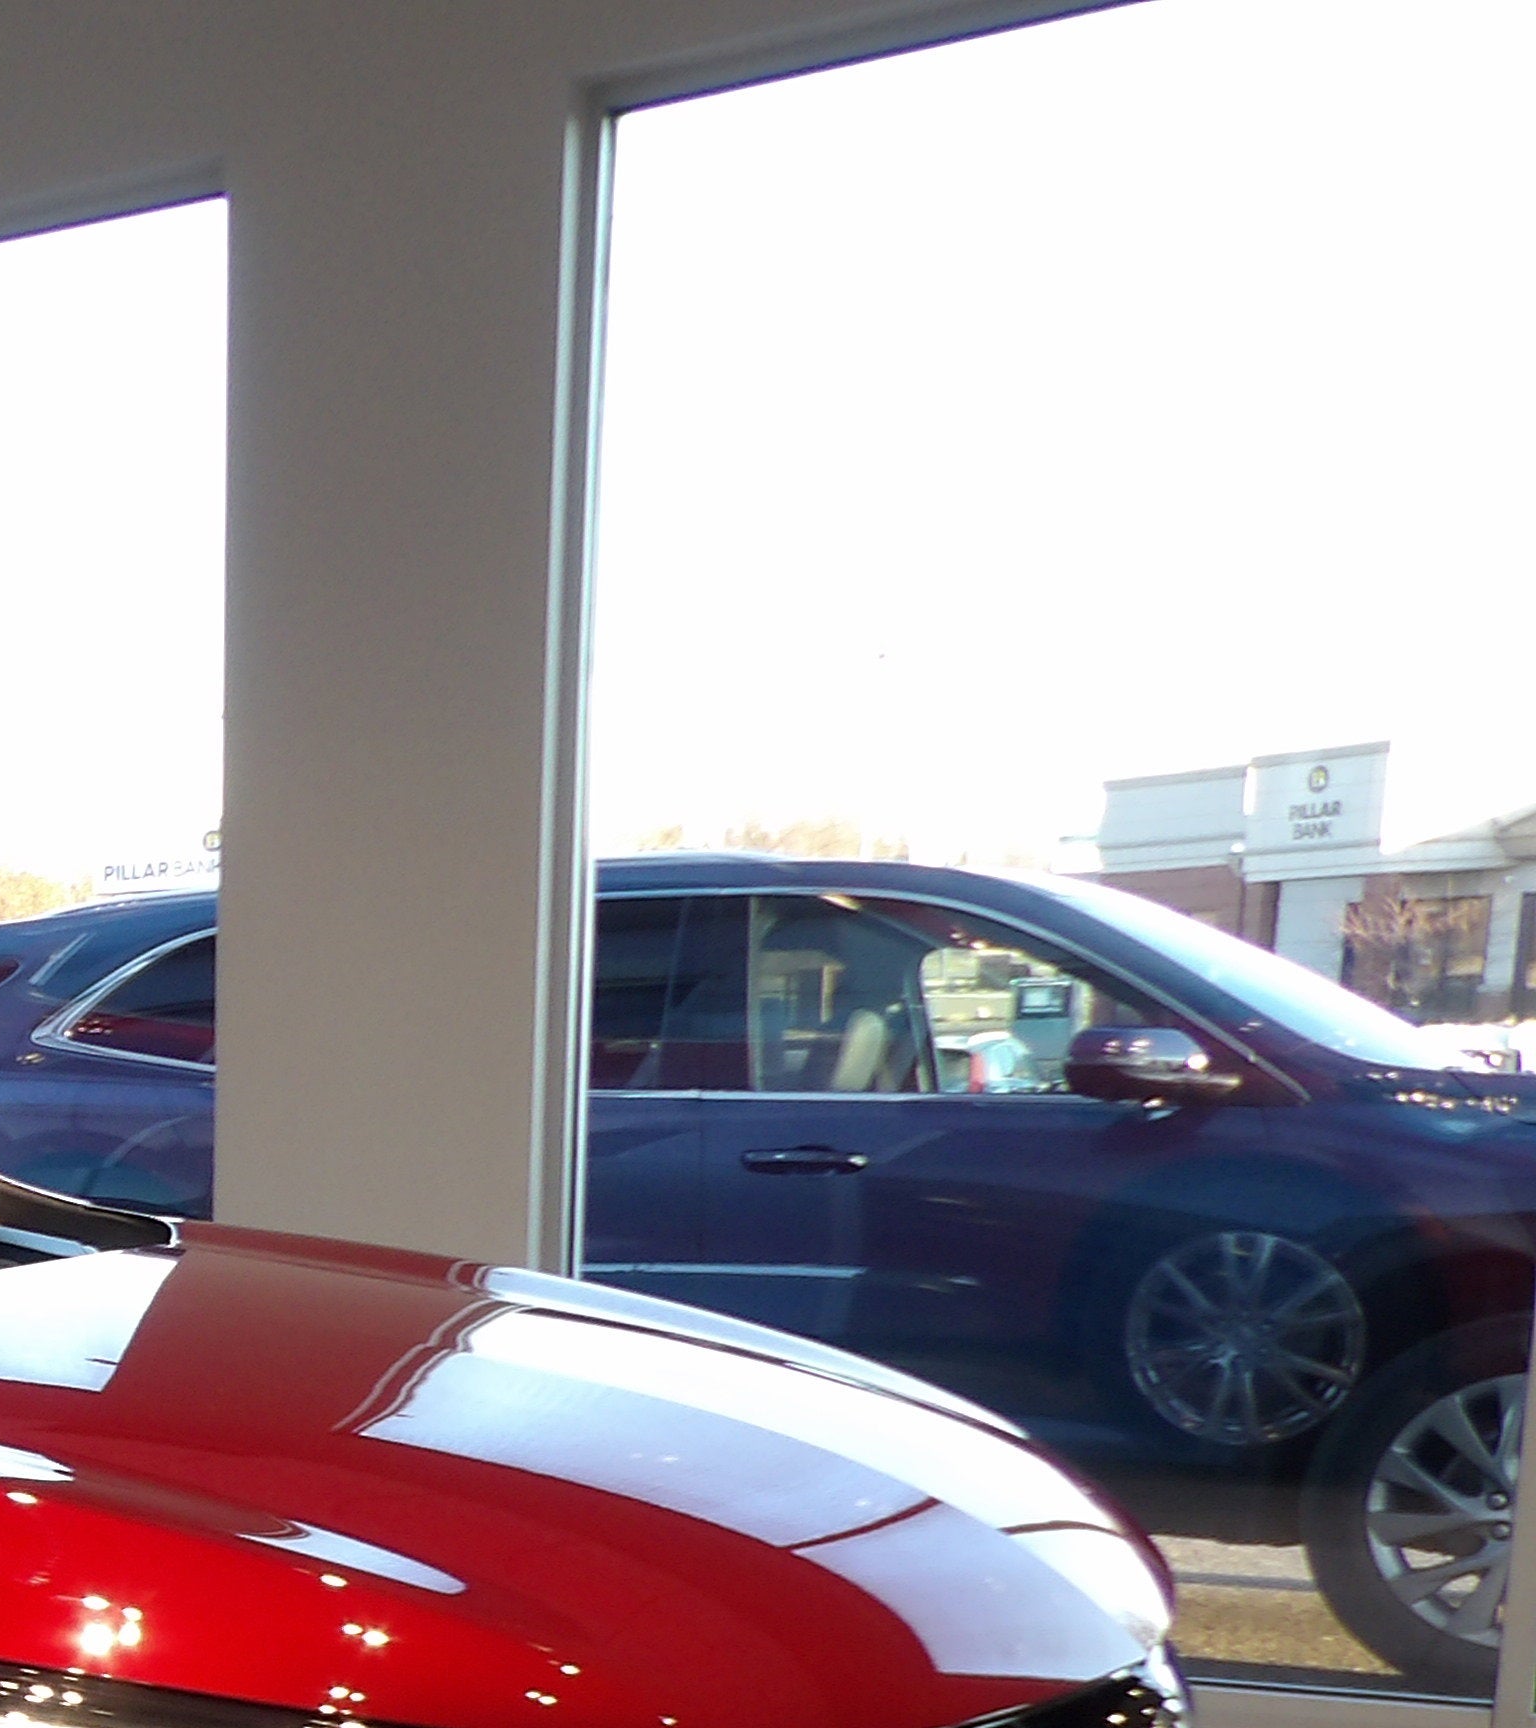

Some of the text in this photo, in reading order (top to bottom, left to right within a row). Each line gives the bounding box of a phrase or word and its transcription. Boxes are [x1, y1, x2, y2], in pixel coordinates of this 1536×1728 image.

[1289, 801, 1341, 820] PILLAR
[1293, 821, 1331, 839] BANK
[104, 862, 168, 881] PILLAR
